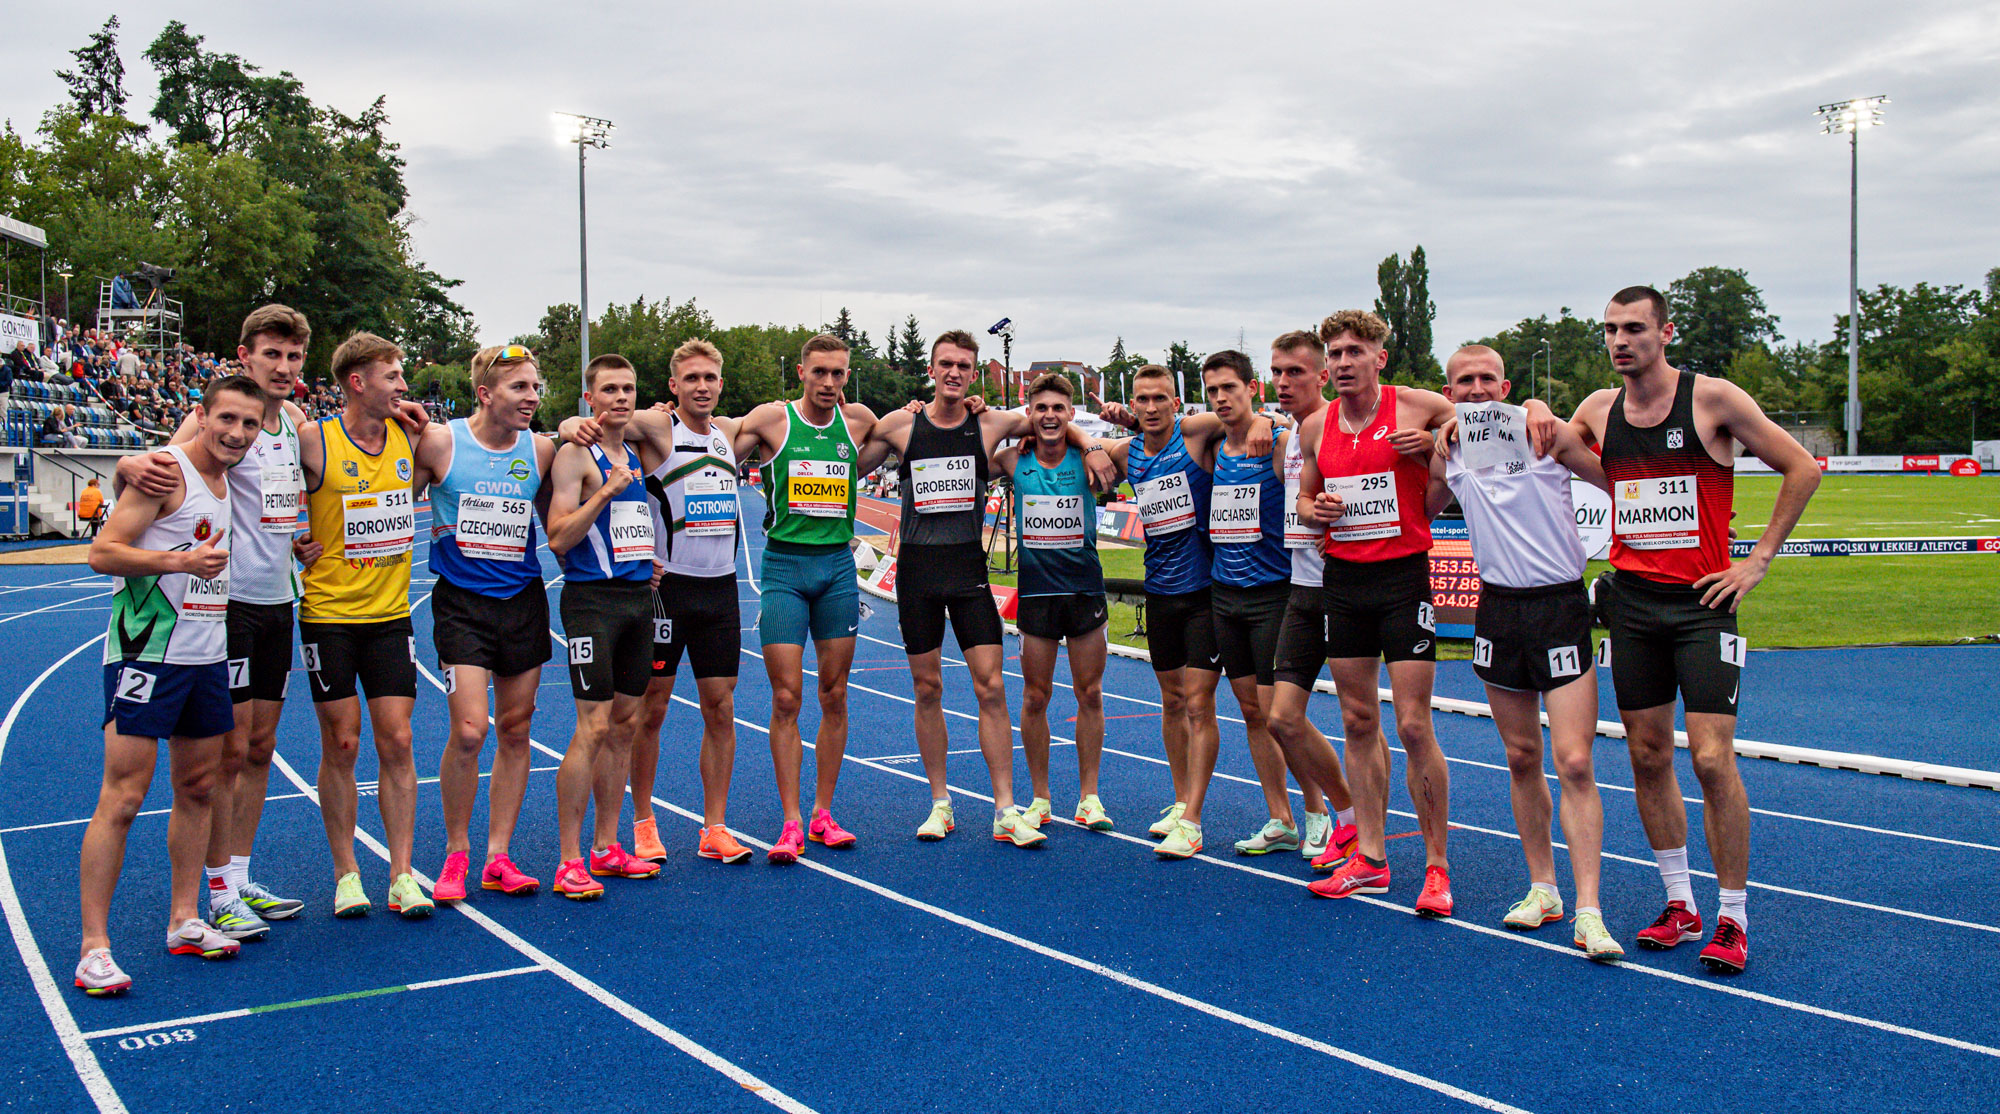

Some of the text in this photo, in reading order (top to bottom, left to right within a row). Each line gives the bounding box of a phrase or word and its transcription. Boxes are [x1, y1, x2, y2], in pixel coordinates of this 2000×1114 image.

[1463, 410, 1511, 425] KRZYWDY
[1467, 428, 1515, 443] NIE MA
[825, 464, 846, 476] 100
[946, 459, 970, 471] 610
[474, 481, 522, 496] GWDA
[719, 479, 733, 491] 177
[793, 483, 846, 497] ROZMYS
[915, 479, 974, 495] GROBERSKI
[1158, 475, 1182, 492] 283
[1361, 476, 1388, 491] 295
[1658, 480, 1689, 495] 311
[386, 492, 408, 507] 511
[1233, 487, 1256, 500] 279
[461, 496, 526, 515] Artisan 565
[687, 500, 736, 515] OSTROWSKI
[1056, 498, 1079, 509] 617
[1139, 494, 1191, 518] WASIEWICZ
[1211, 508, 1258, 522] KUCHARSKI
[1618, 505, 1695, 526] MARMON
[347, 514, 412, 536] BOROWSKI
[460, 520, 527, 539] CZECHOWICZ
[1025, 517, 1082, 530] KOMODA
[611, 525, 654, 541] WYDERKA
[1832, 542, 1867, 553] POLSKI
[1868, 542, 1880, 552] W
[1882, 541, 1918, 553] LEKKIEJ
[1920, 541, 1968, 551] ATLETYCE
[304, 646, 315, 669] 3
[570, 641, 592, 659] 15
[1476, 641, 1490, 662] 11
[1727, 638, 1738, 663] 1
[1552, 650, 1577, 672] 11
[229, 661, 245, 686] 7
[124, 672, 148, 700] 2
